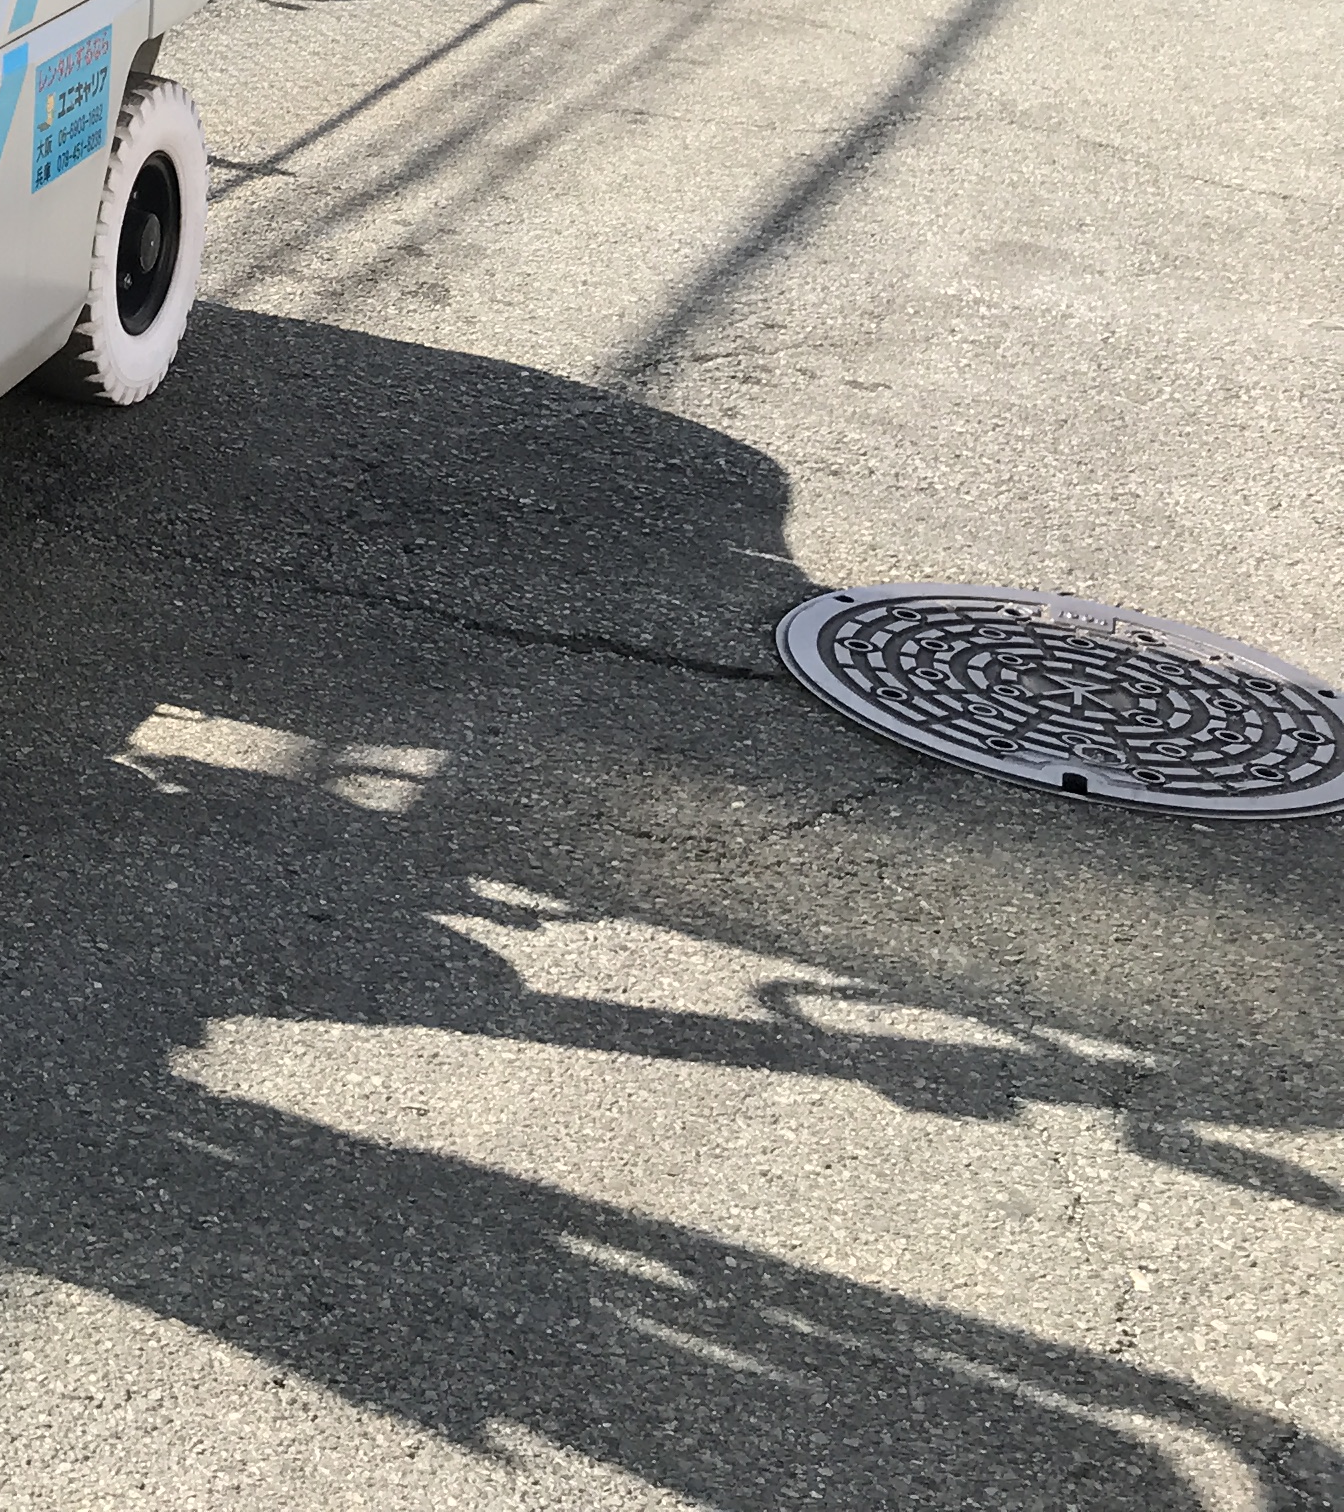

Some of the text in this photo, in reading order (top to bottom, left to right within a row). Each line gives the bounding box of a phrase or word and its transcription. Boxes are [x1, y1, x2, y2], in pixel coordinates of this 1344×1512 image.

[38, 31, 109, 93] レンタルするなら
[57, 66, 108, 119] ユニキャリア
[36, 135, 53, 163] 大阪
[35, 162, 52, 188] 兵庫
